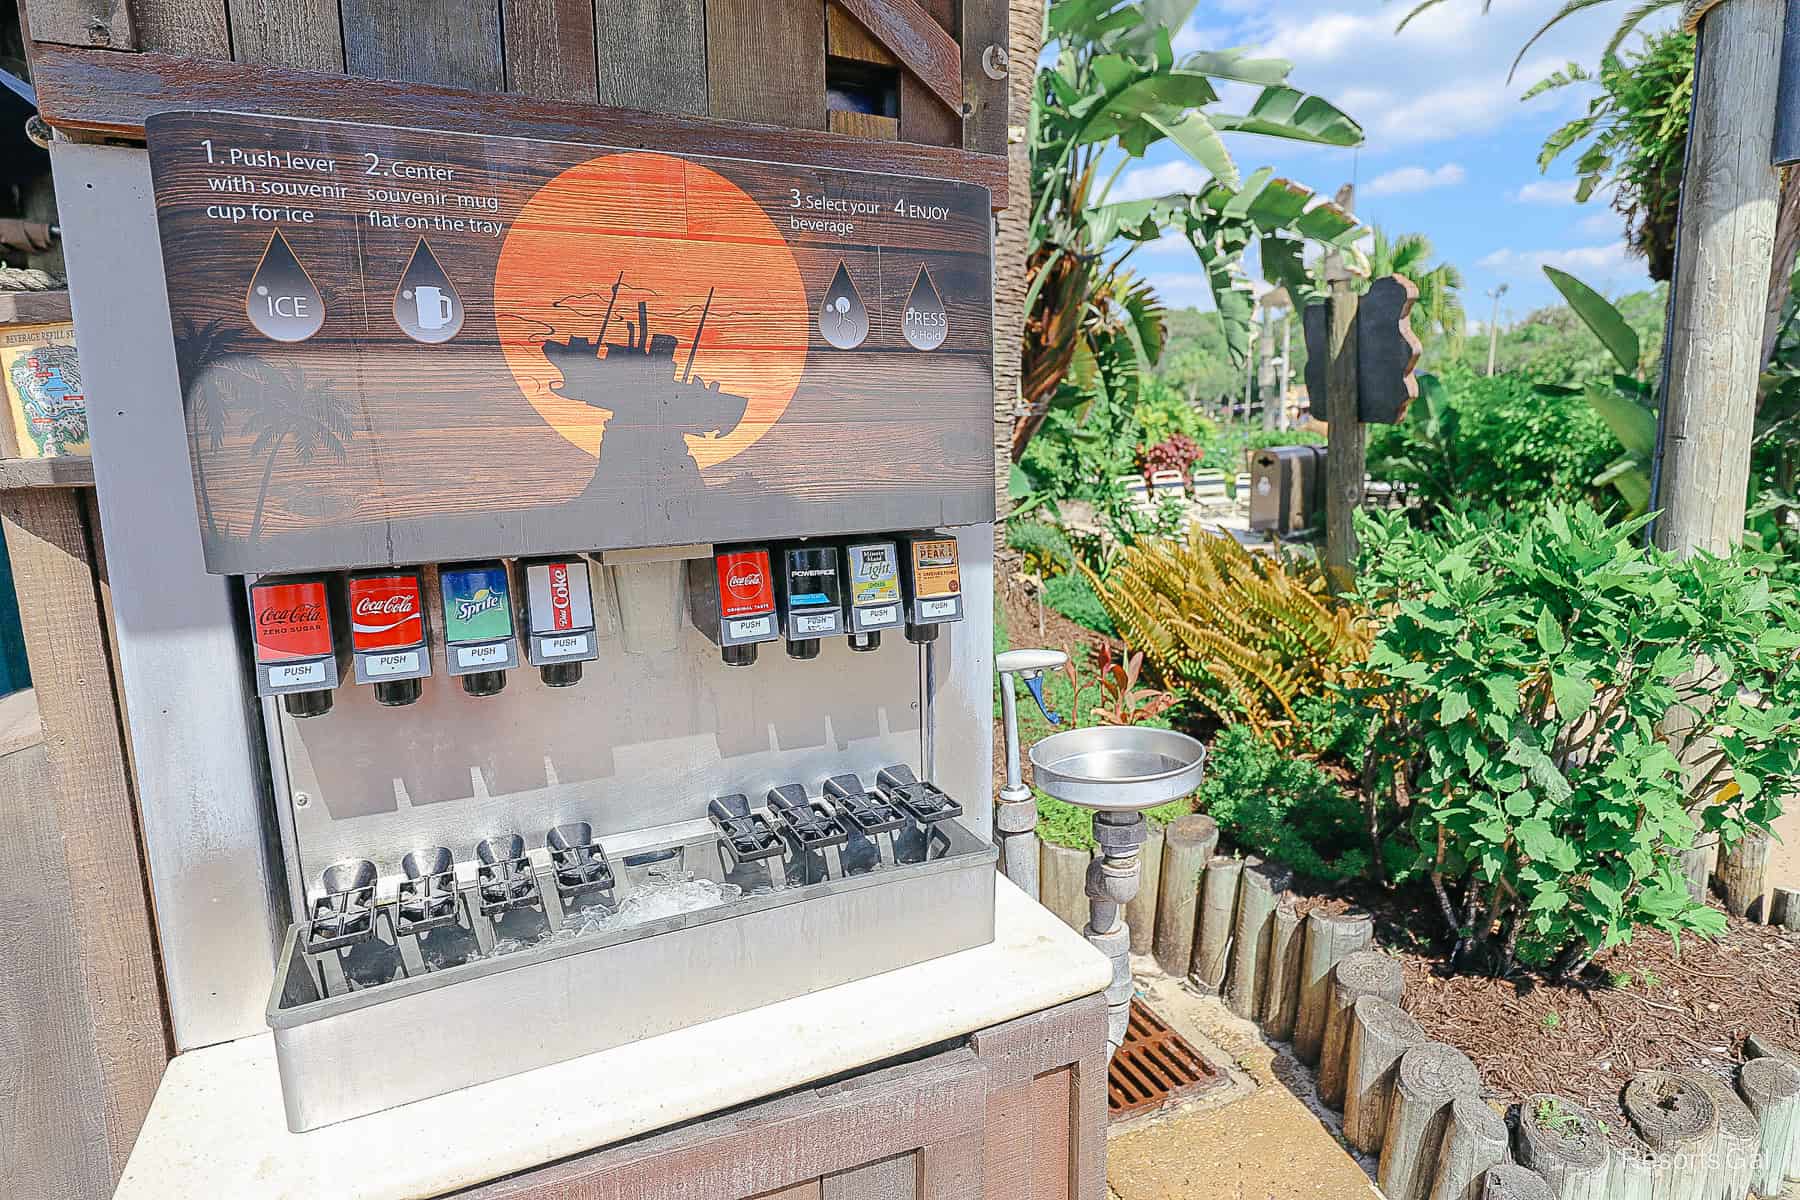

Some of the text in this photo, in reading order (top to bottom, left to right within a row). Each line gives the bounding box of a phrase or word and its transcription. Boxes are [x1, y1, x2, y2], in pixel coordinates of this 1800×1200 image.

[230, 148, 281, 169] Push
[286, 151, 336, 172] lever
[391, 161, 455, 181] Center
[207, 174, 348, 199] with souvenir
[367, 187, 499, 213] souvenir mug
[206, 204, 314, 224] cup for ice
[850, 203, 880, 216] your
[909, 205, 950, 221] ENJOY
[369, 210, 503, 237] flat on the tray
[790, 216, 854, 236] beverage
[266, 295, 309, 318] ICE
[905, 311, 946, 327] PRESS
[6, 332, 40, 344] BEVERAGE
[919, 331, 941, 341] Hold
[920, 548, 946, 559] PEAK
[861, 562, 891, 580] Light
[729, 573, 761, 587] Coca-Cola
[552, 568, 569, 609] Coke
[356, 594, 414, 616] Coca-Cola
[457, 594, 499, 624] Sprite
[870, 609, 888, 617] PUSH
[260, 603, 323, 626] Coca-Cola
[807, 615, 826, 625] PUSH
[291, 624, 321, 633] SUGAR
[740, 621, 760, 630] PUSH
[553, 639, 577, 648] PUSH
[380, 655, 406, 665] PUSH
[471, 647, 496, 657] PUSH
[284, 666, 312, 676] PUSH
